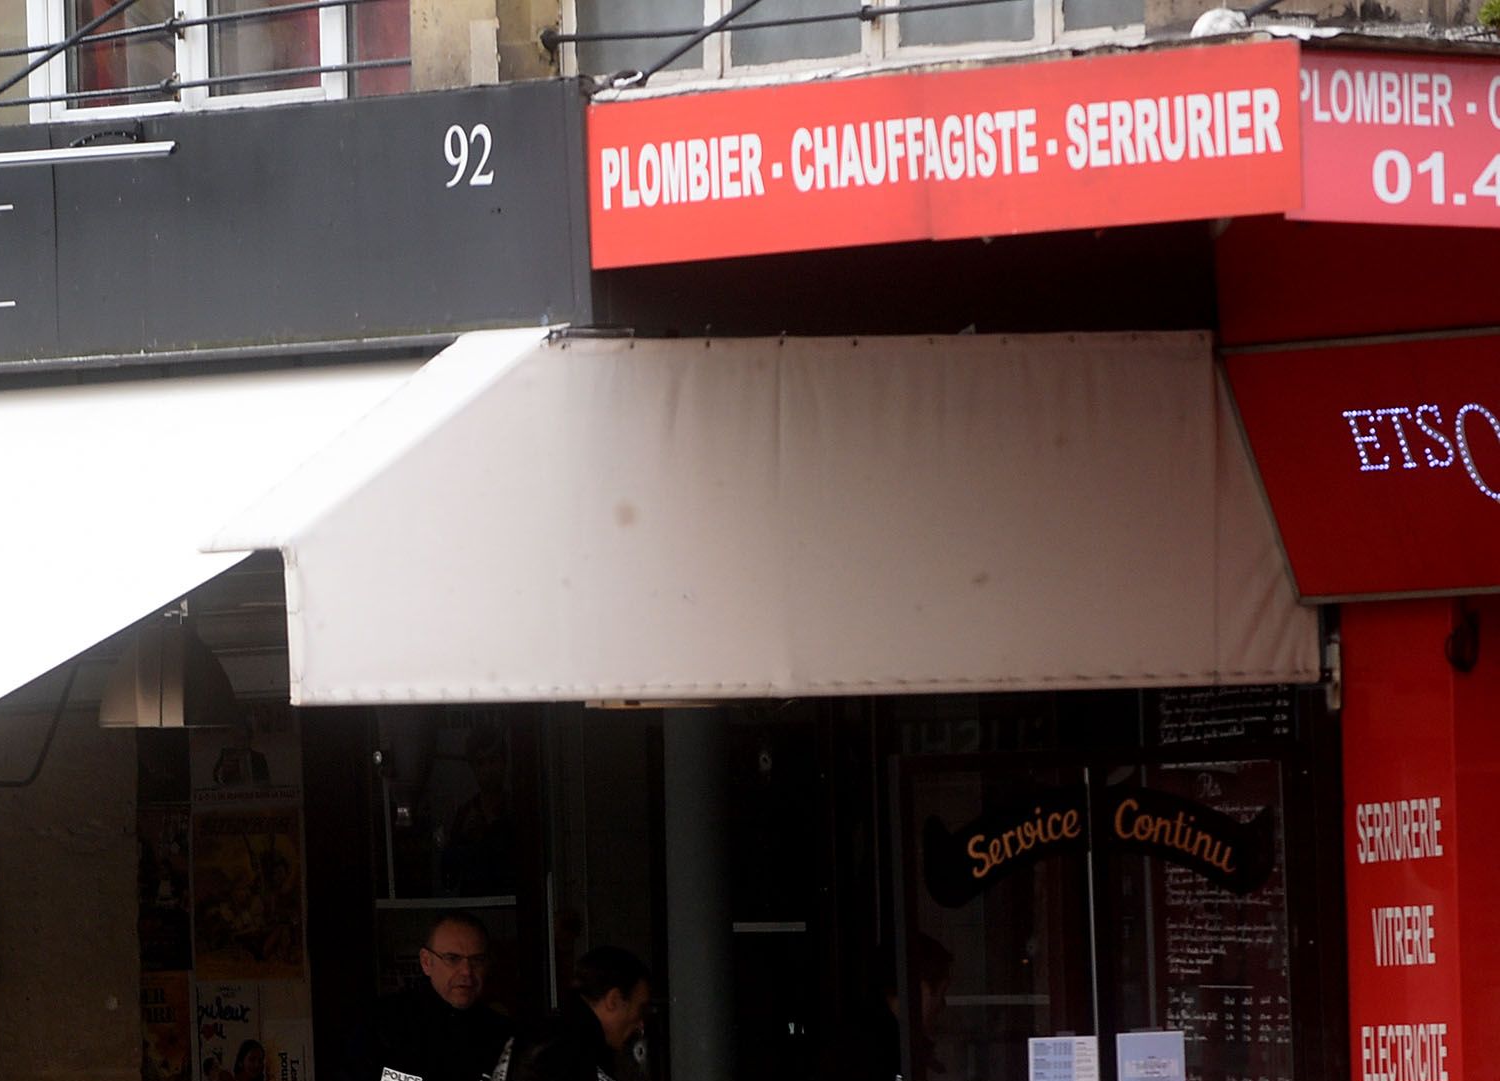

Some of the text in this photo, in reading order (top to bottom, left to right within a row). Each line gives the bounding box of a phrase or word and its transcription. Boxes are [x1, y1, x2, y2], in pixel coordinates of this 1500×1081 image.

[443, 123, 495, 188] 92
[601, 133, 765, 210] PLOMBIER
[790, 108, 1039, 192] CHAUFFAGISTE
[1065, 87, 1284, 170] SERRURIER
[966, 797, 1237, 880] Service Continu
[1356, 797, 1444, 865] SERRURERIE
[1371, 904, 1437, 967] VITRERIE
